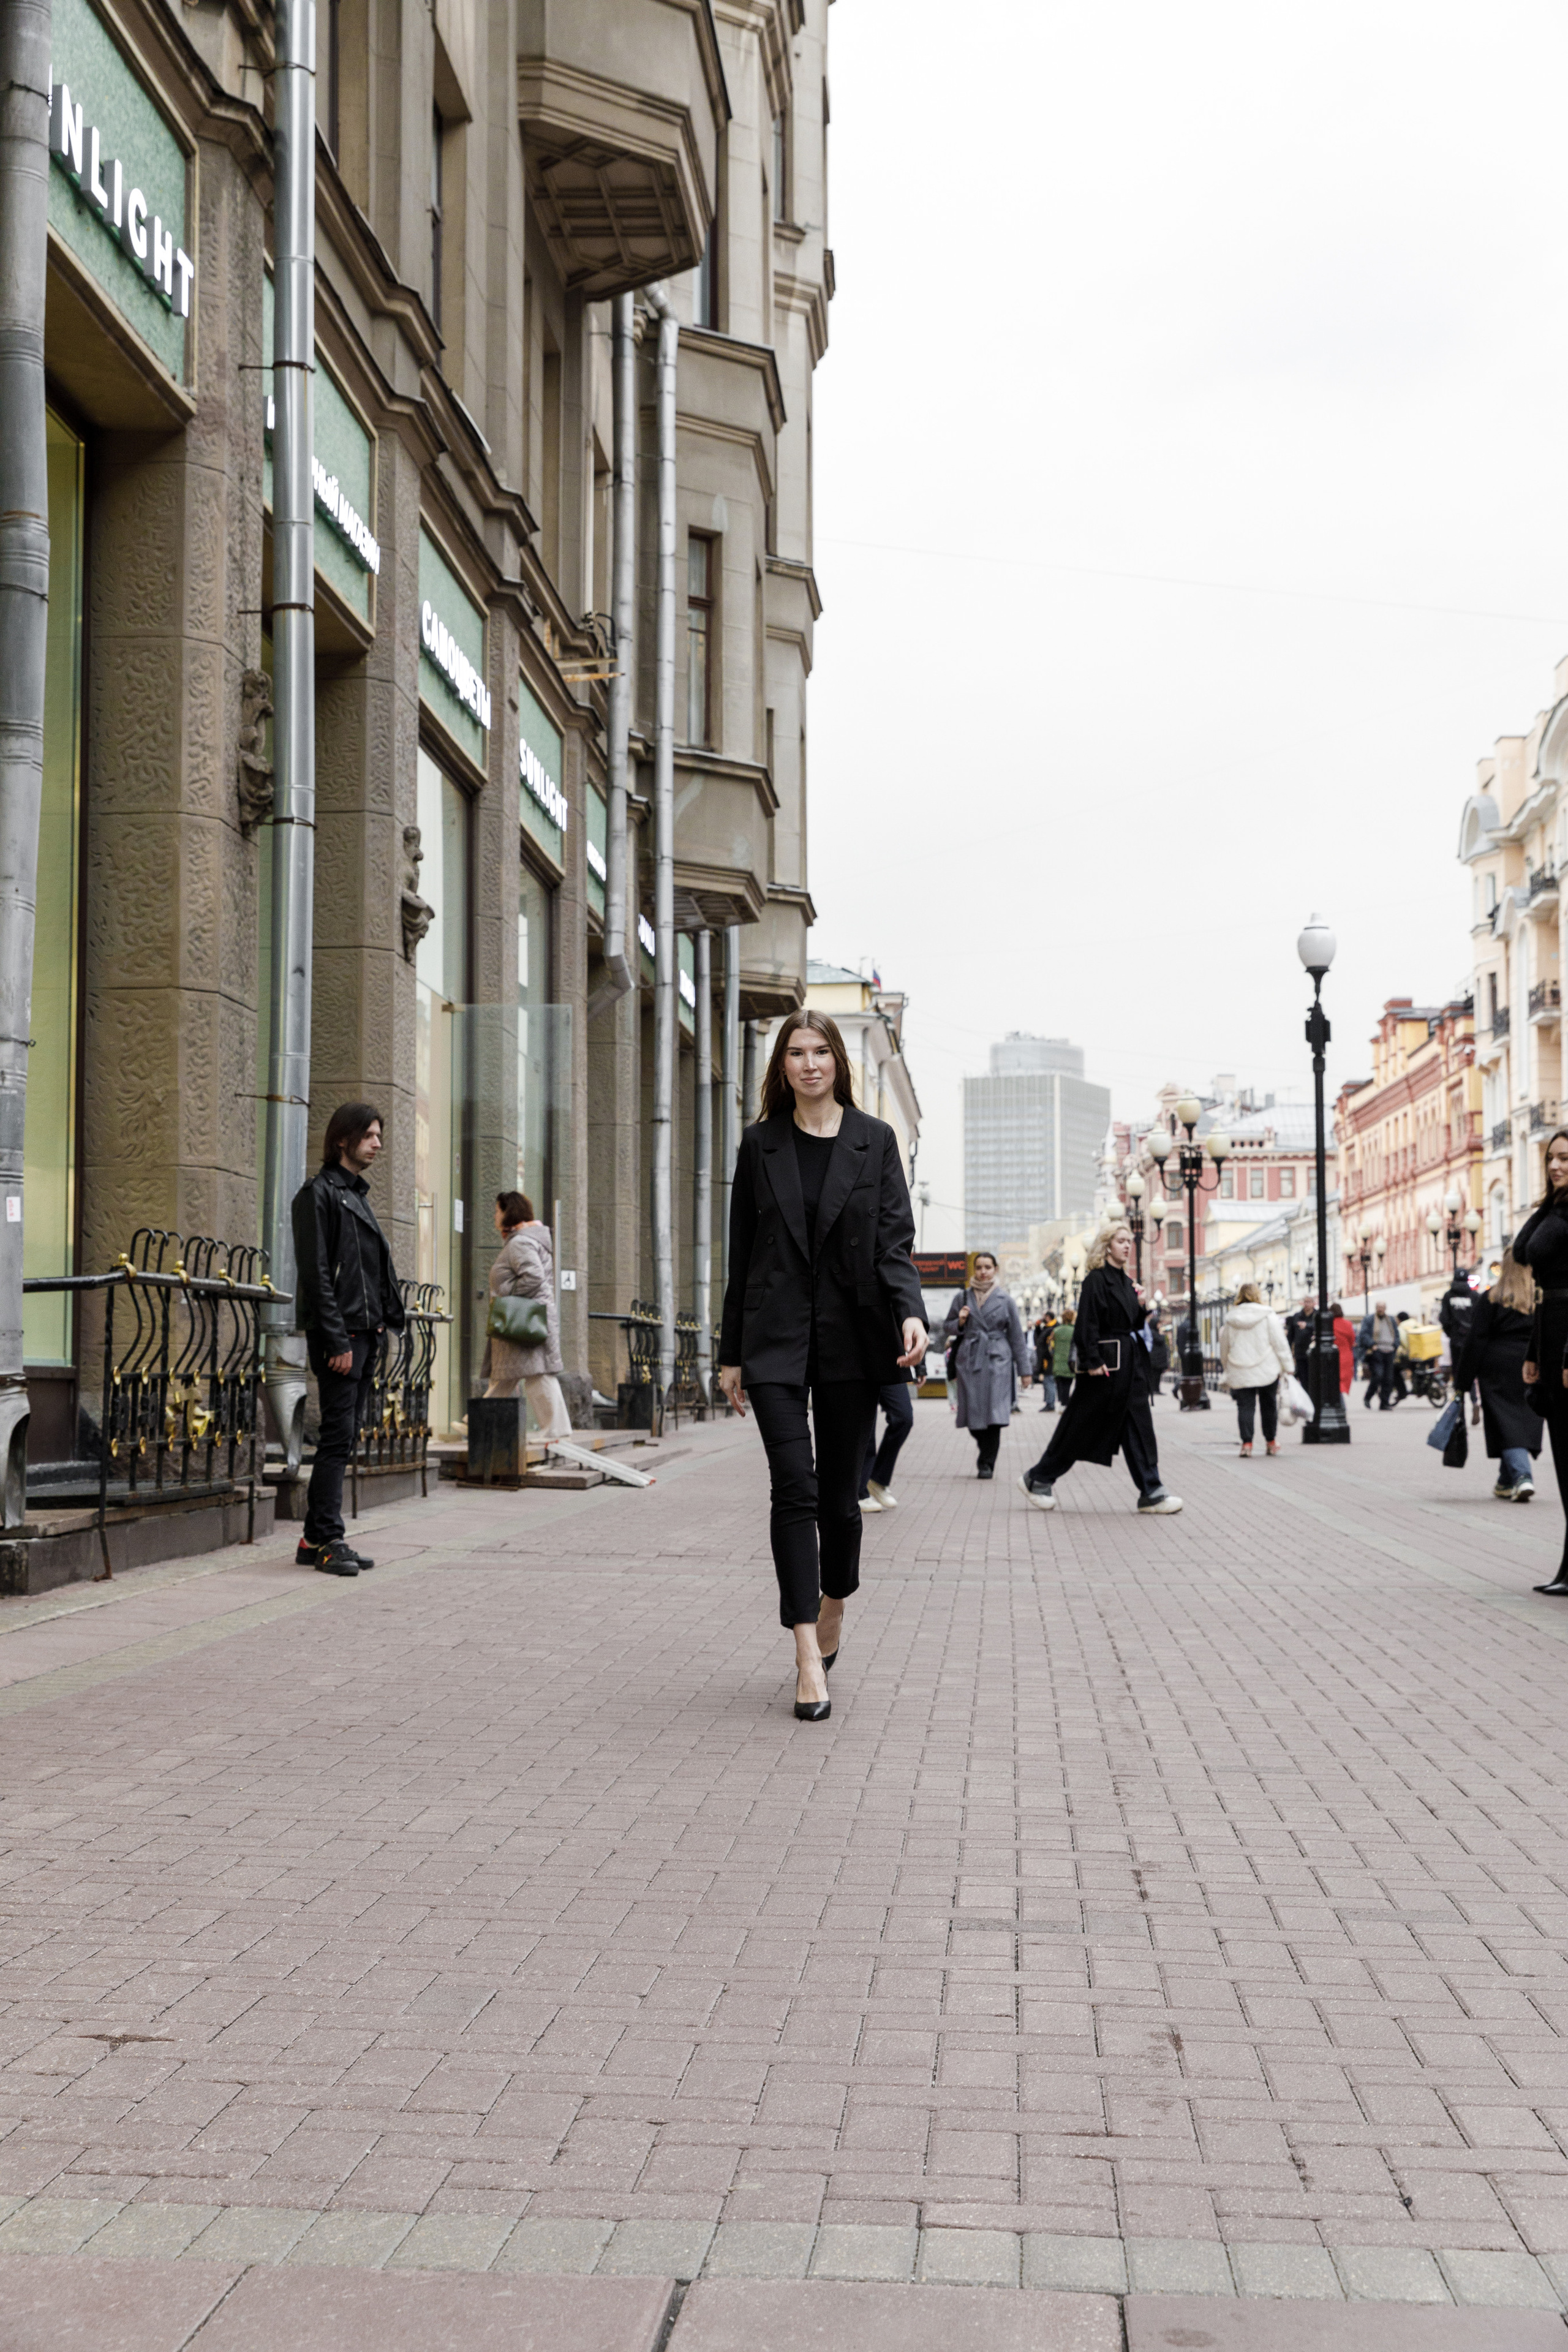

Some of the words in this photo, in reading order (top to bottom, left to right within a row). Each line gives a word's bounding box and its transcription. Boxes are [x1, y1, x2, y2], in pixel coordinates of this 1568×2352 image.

[48, 63, 194, 318] NLIGHT
[338, 492, 380, 575] МАГАЗИН
[422, 600, 491, 730] САМОЦВЕТЫ
[519, 738, 568, 832] SUNLIGHT
